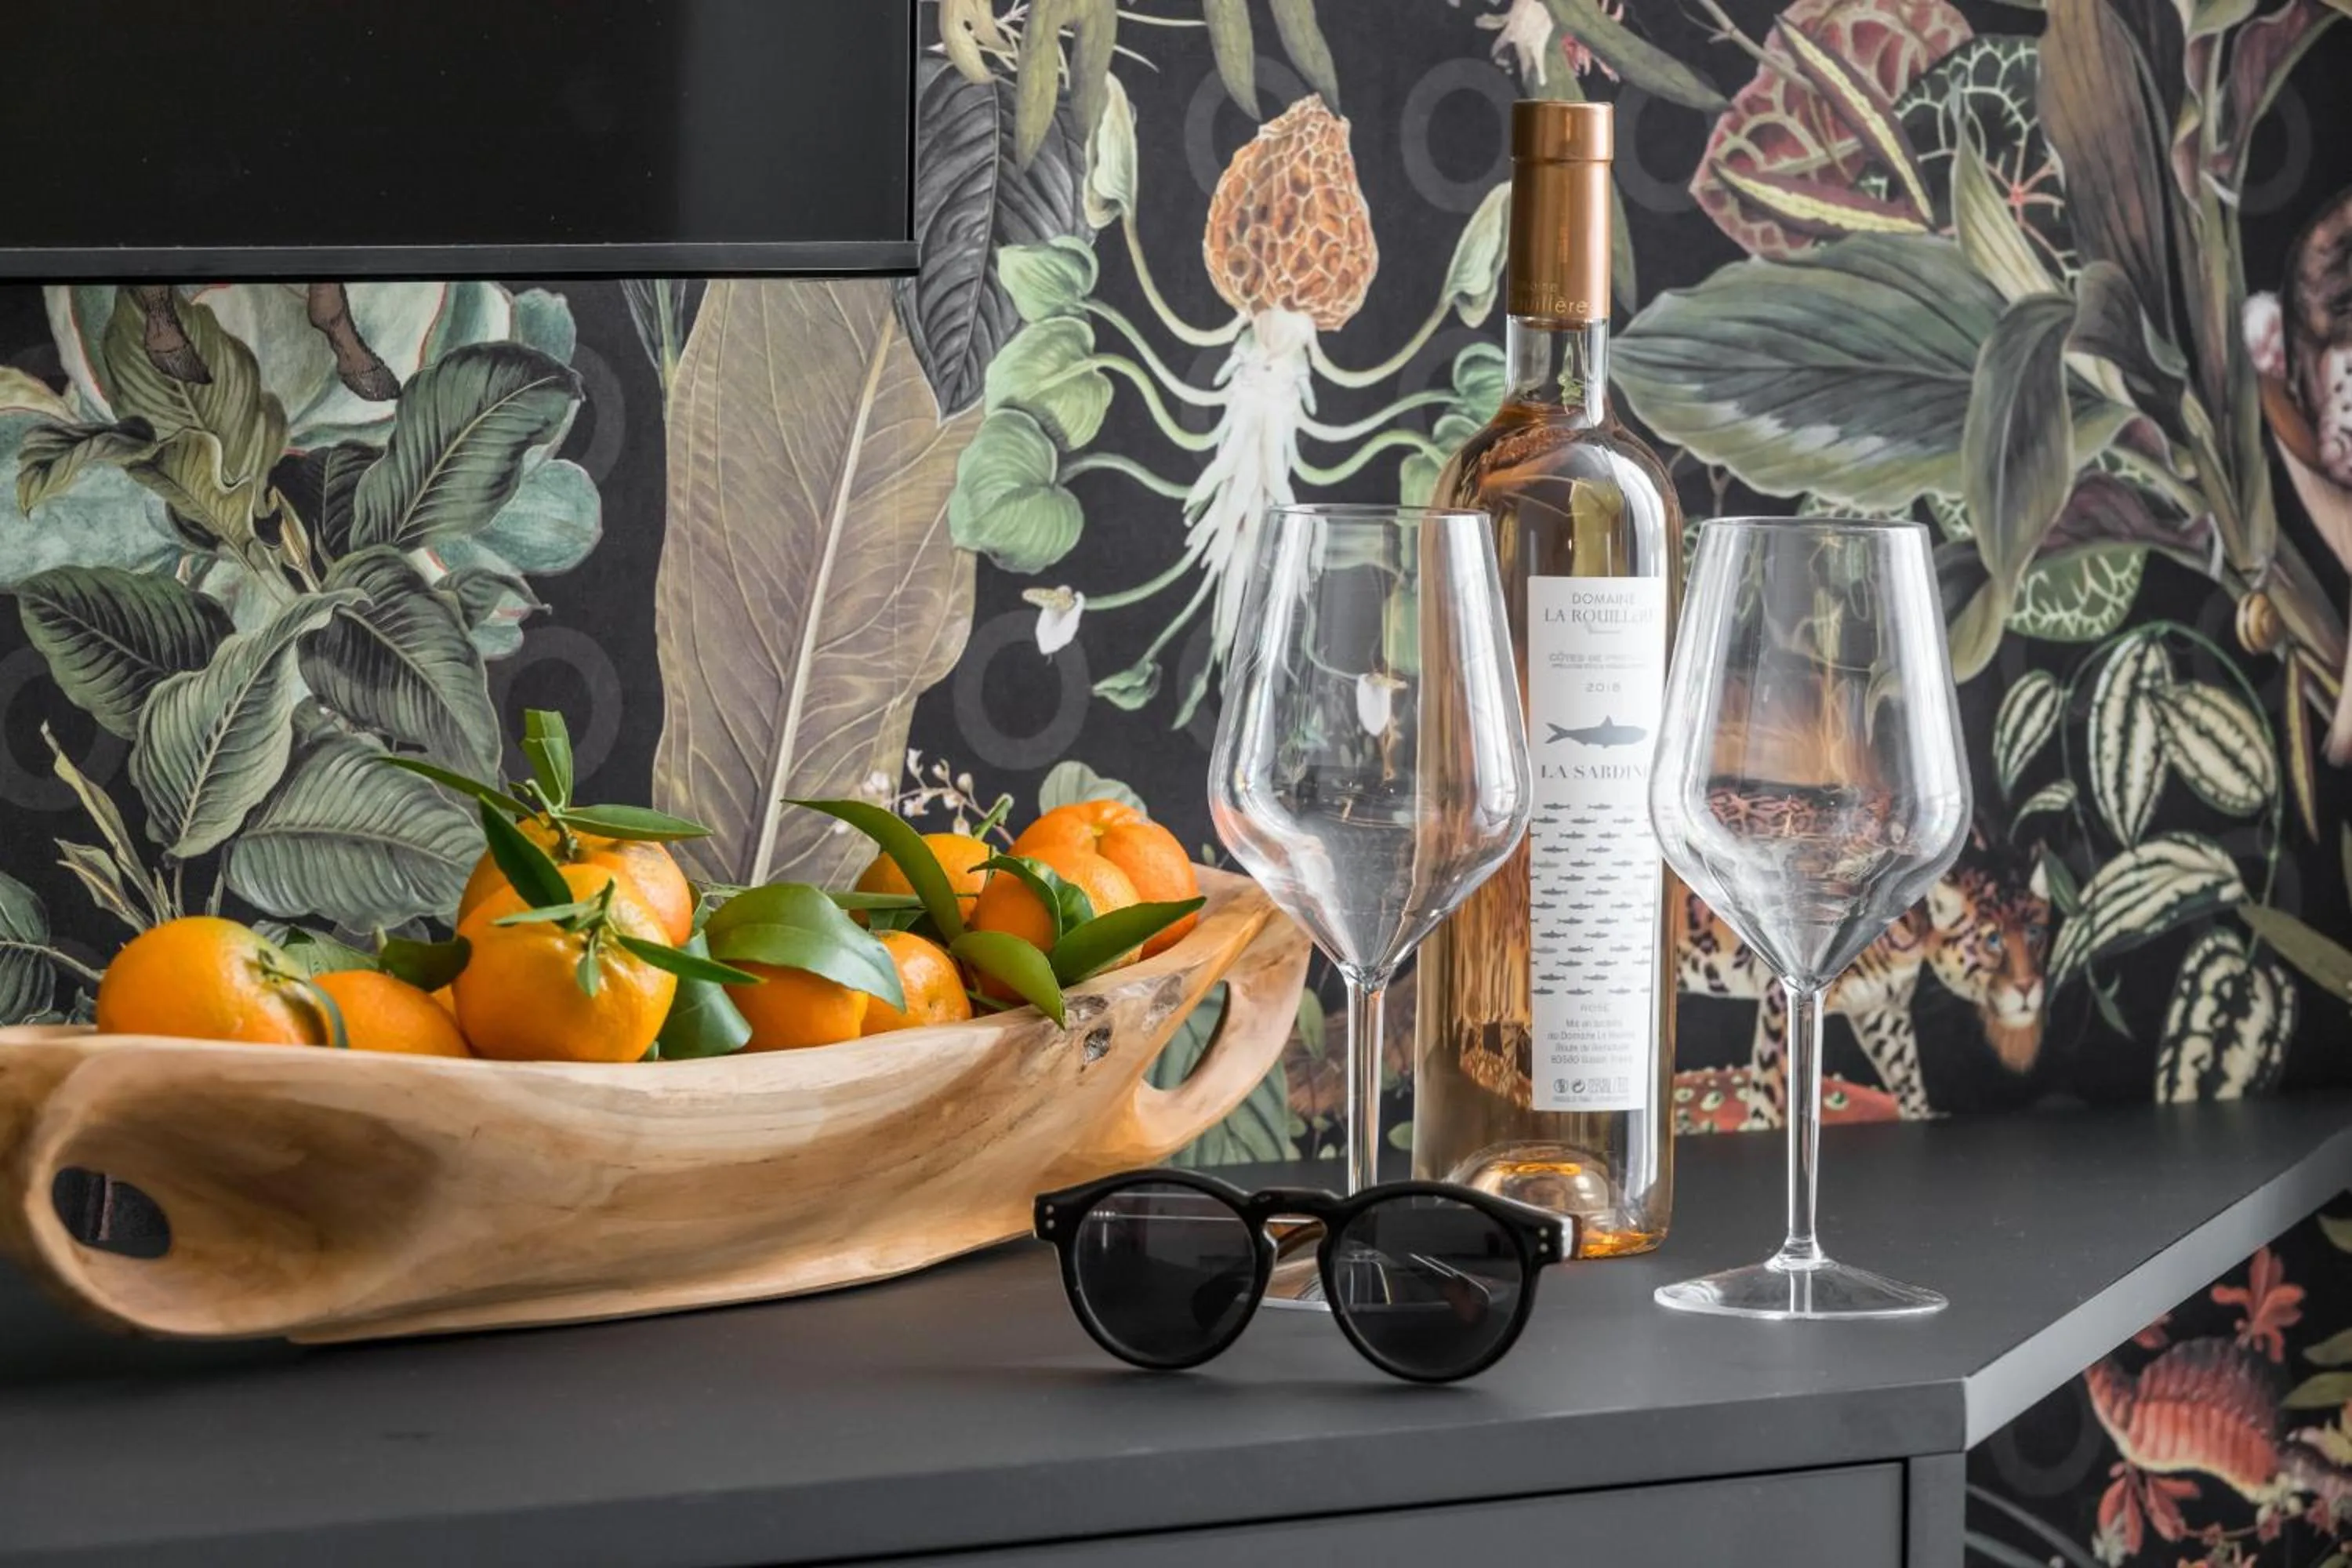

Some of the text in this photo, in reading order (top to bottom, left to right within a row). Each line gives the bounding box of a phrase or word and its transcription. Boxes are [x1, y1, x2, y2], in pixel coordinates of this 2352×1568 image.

[1572, 592, 1636, 604] DOMAINE
[1544, 608, 1566, 622] LA
[1541, 764, 1648, 779] LA SARDIN
